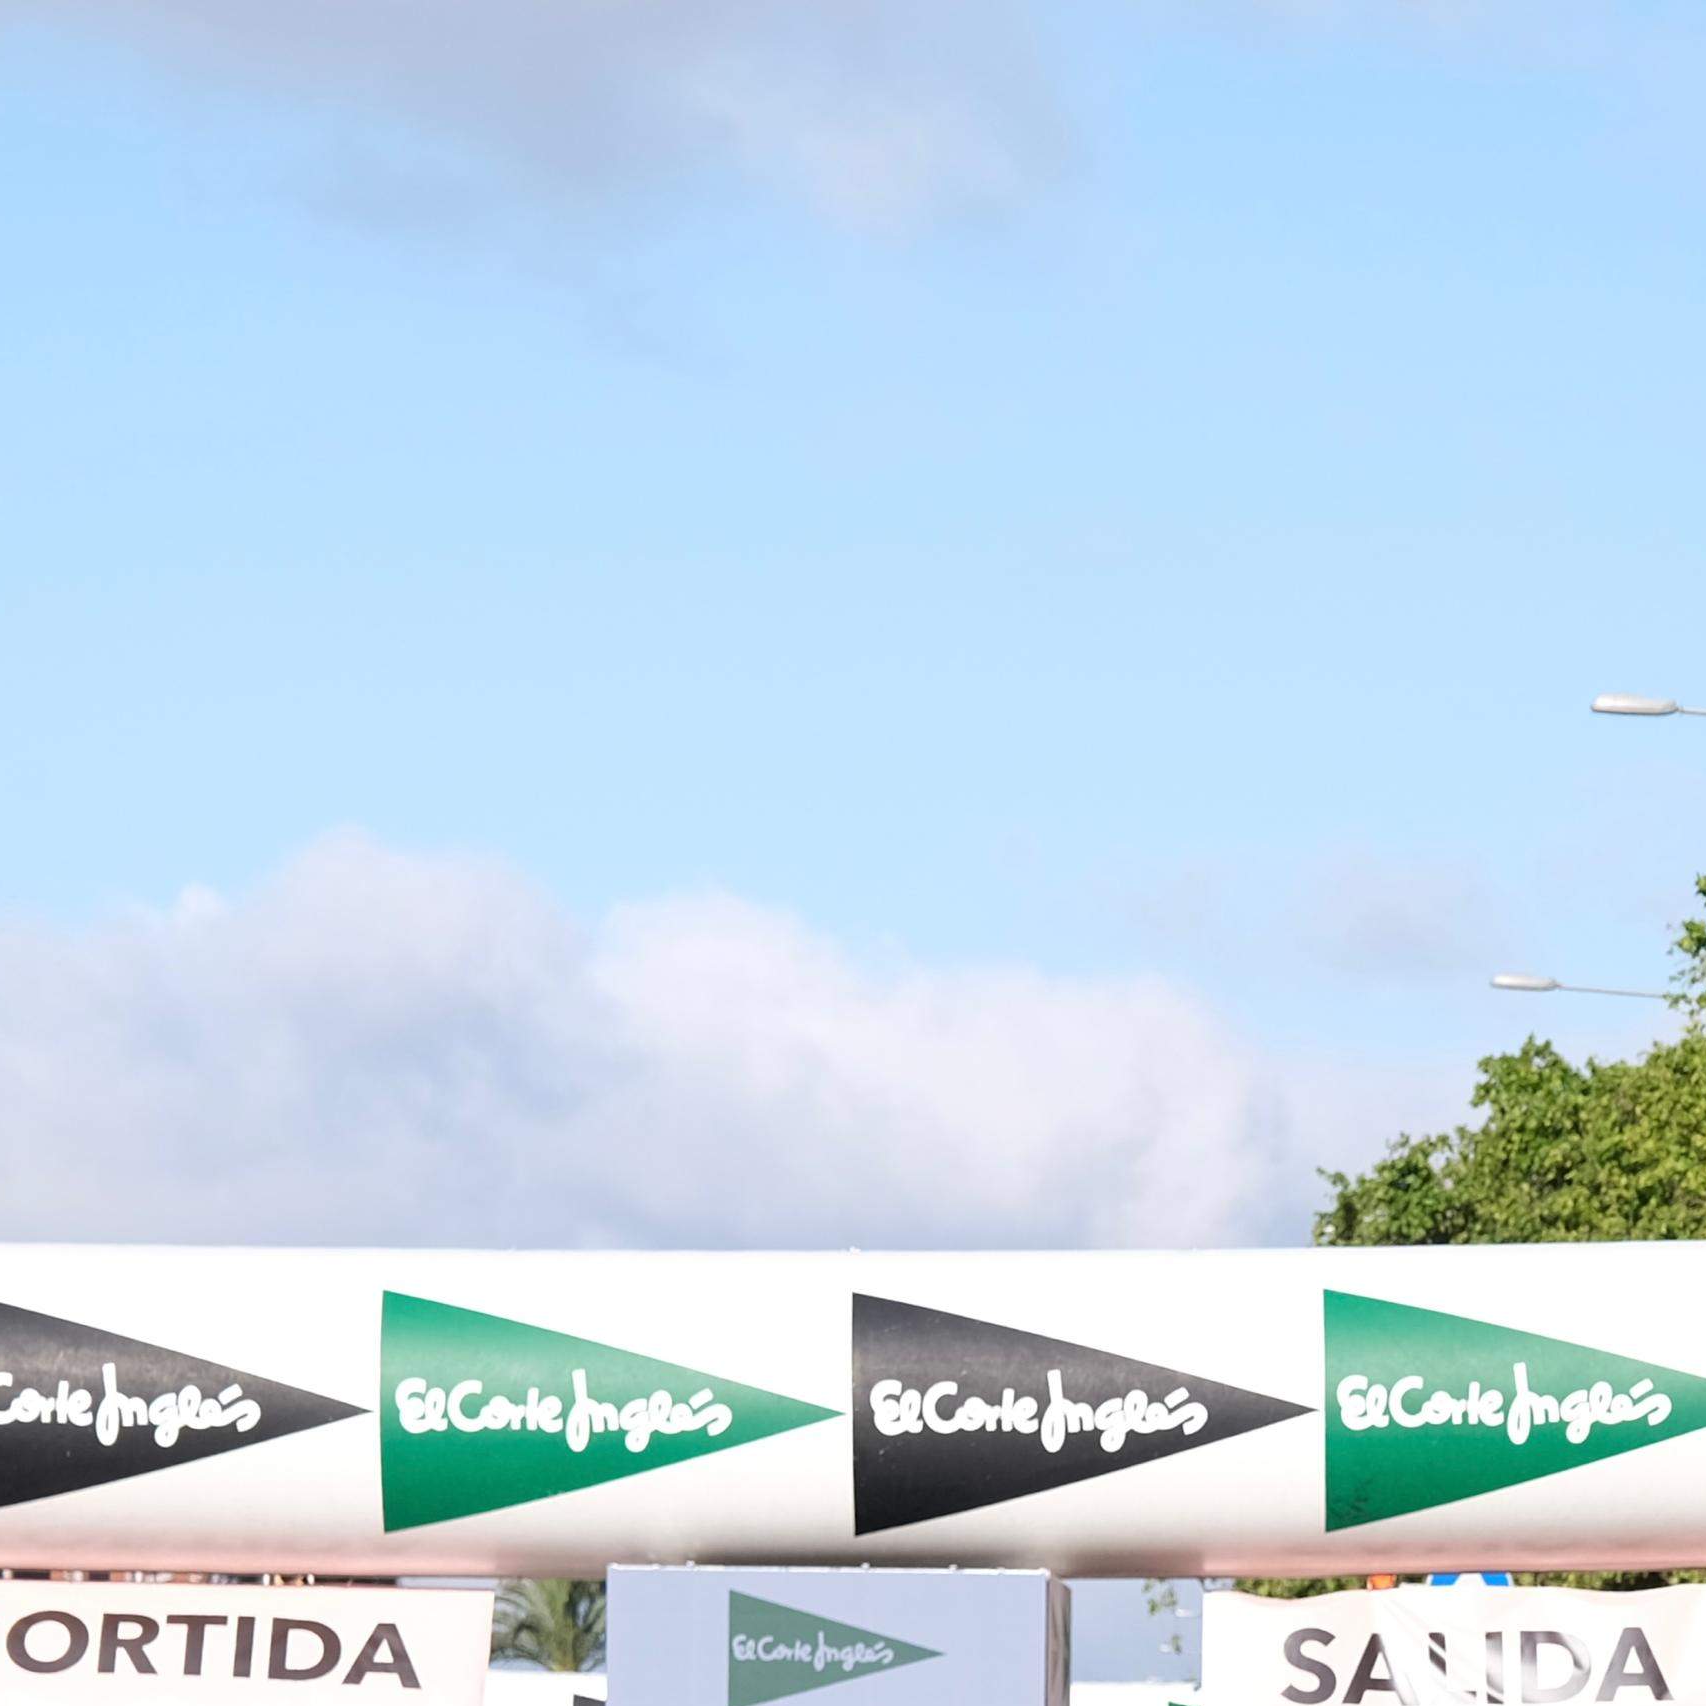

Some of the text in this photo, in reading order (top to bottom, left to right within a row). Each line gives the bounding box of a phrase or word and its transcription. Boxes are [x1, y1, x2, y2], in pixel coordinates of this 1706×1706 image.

[90, 1363, 261, 1447] Inglés
[395, 1369, 733, 1453] El Corte Inglés
[870, 1369, 1209, 1453] El Corte Inglés
[1337, 1362, 1673, 1445] El Corte Inglés
[732, 1630, 895, 1672] El Corte Inglés
[1280, 1627, 1674, 1706] SALIDA
